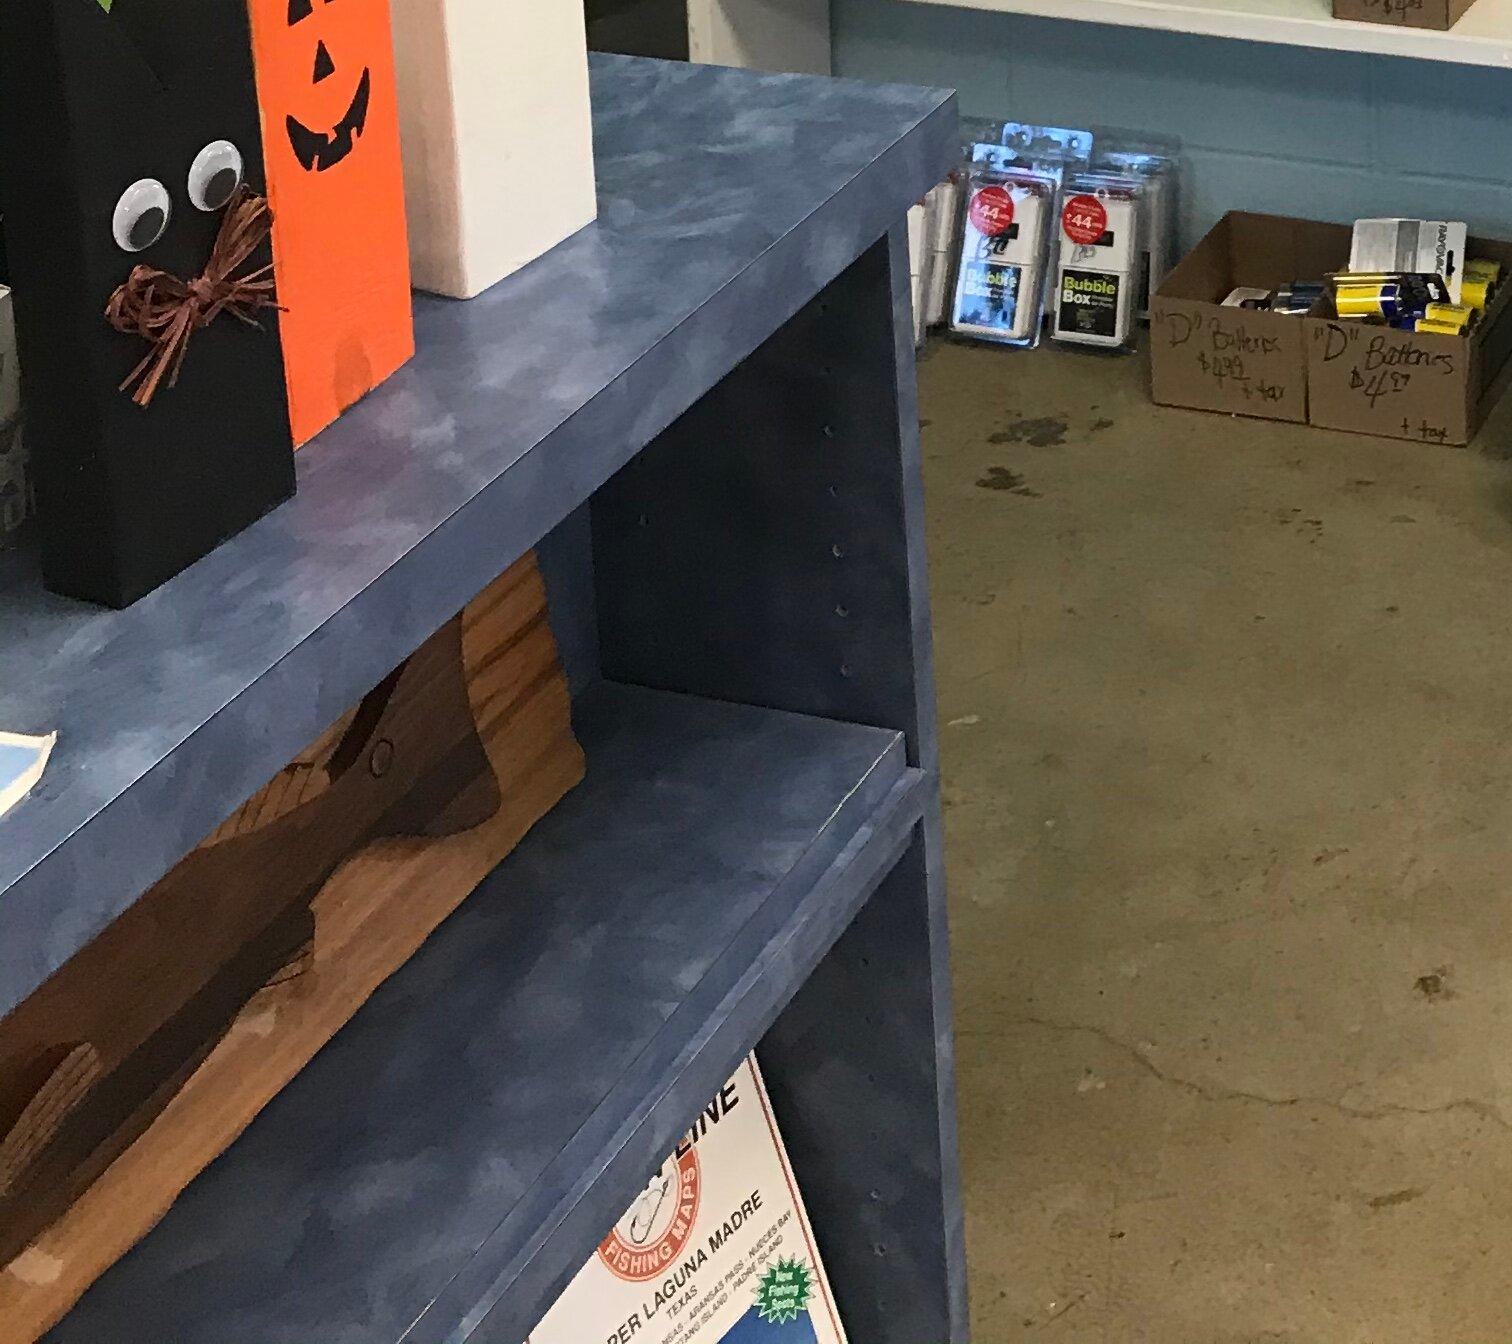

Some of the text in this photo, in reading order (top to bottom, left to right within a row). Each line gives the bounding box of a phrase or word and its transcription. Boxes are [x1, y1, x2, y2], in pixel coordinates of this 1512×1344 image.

[1062, 288, 1091, 306] Box
[1063, 275, 1116, 296] Bubble
[605, 1164, 698, 1275] FISHING MAPS
[642, 1188, 766, 1319] LAGUNA MADRE
[665, 1283, 700, 1322] TEXAS
